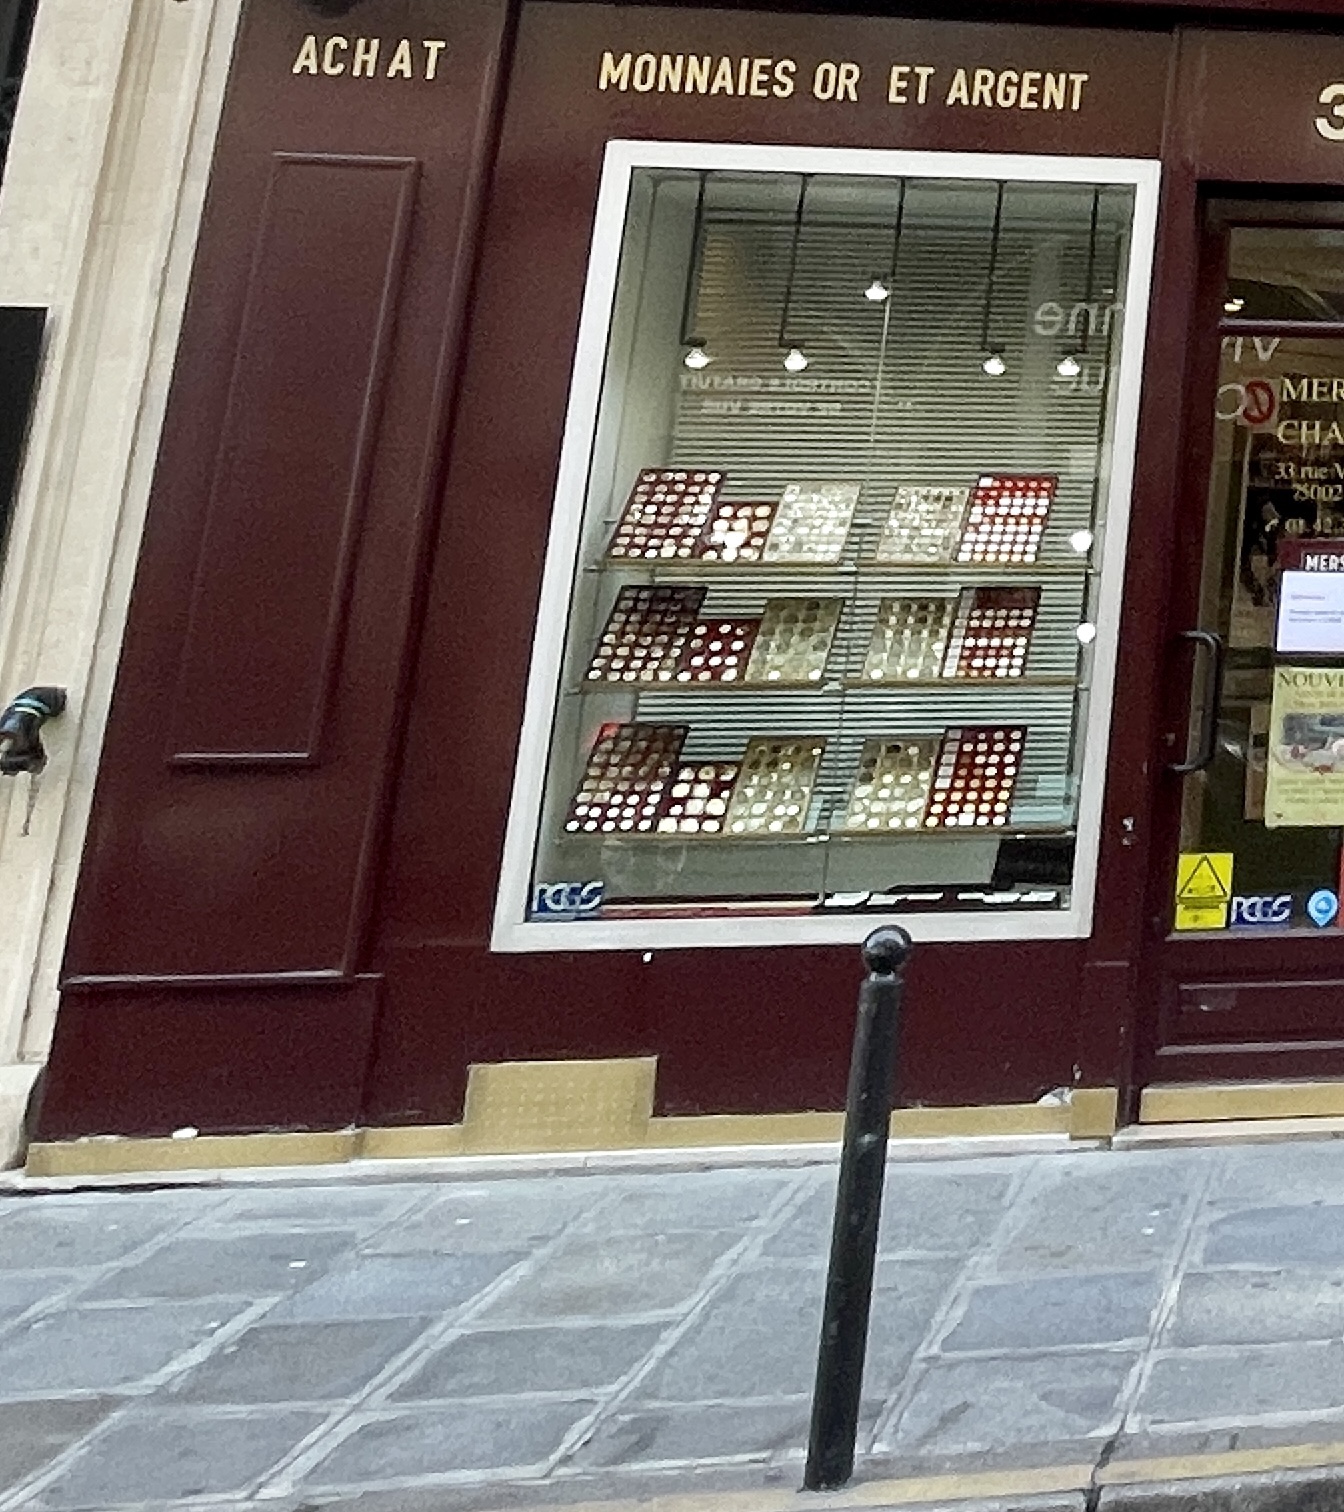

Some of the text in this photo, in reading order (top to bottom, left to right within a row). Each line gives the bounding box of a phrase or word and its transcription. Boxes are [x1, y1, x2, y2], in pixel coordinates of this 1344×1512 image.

[291, 35, 446, 81] ACHAT
[598, 51, 1089, 111] MONNAIES OR ET ARGENT
[1300, 466, 1329, 480] rue
